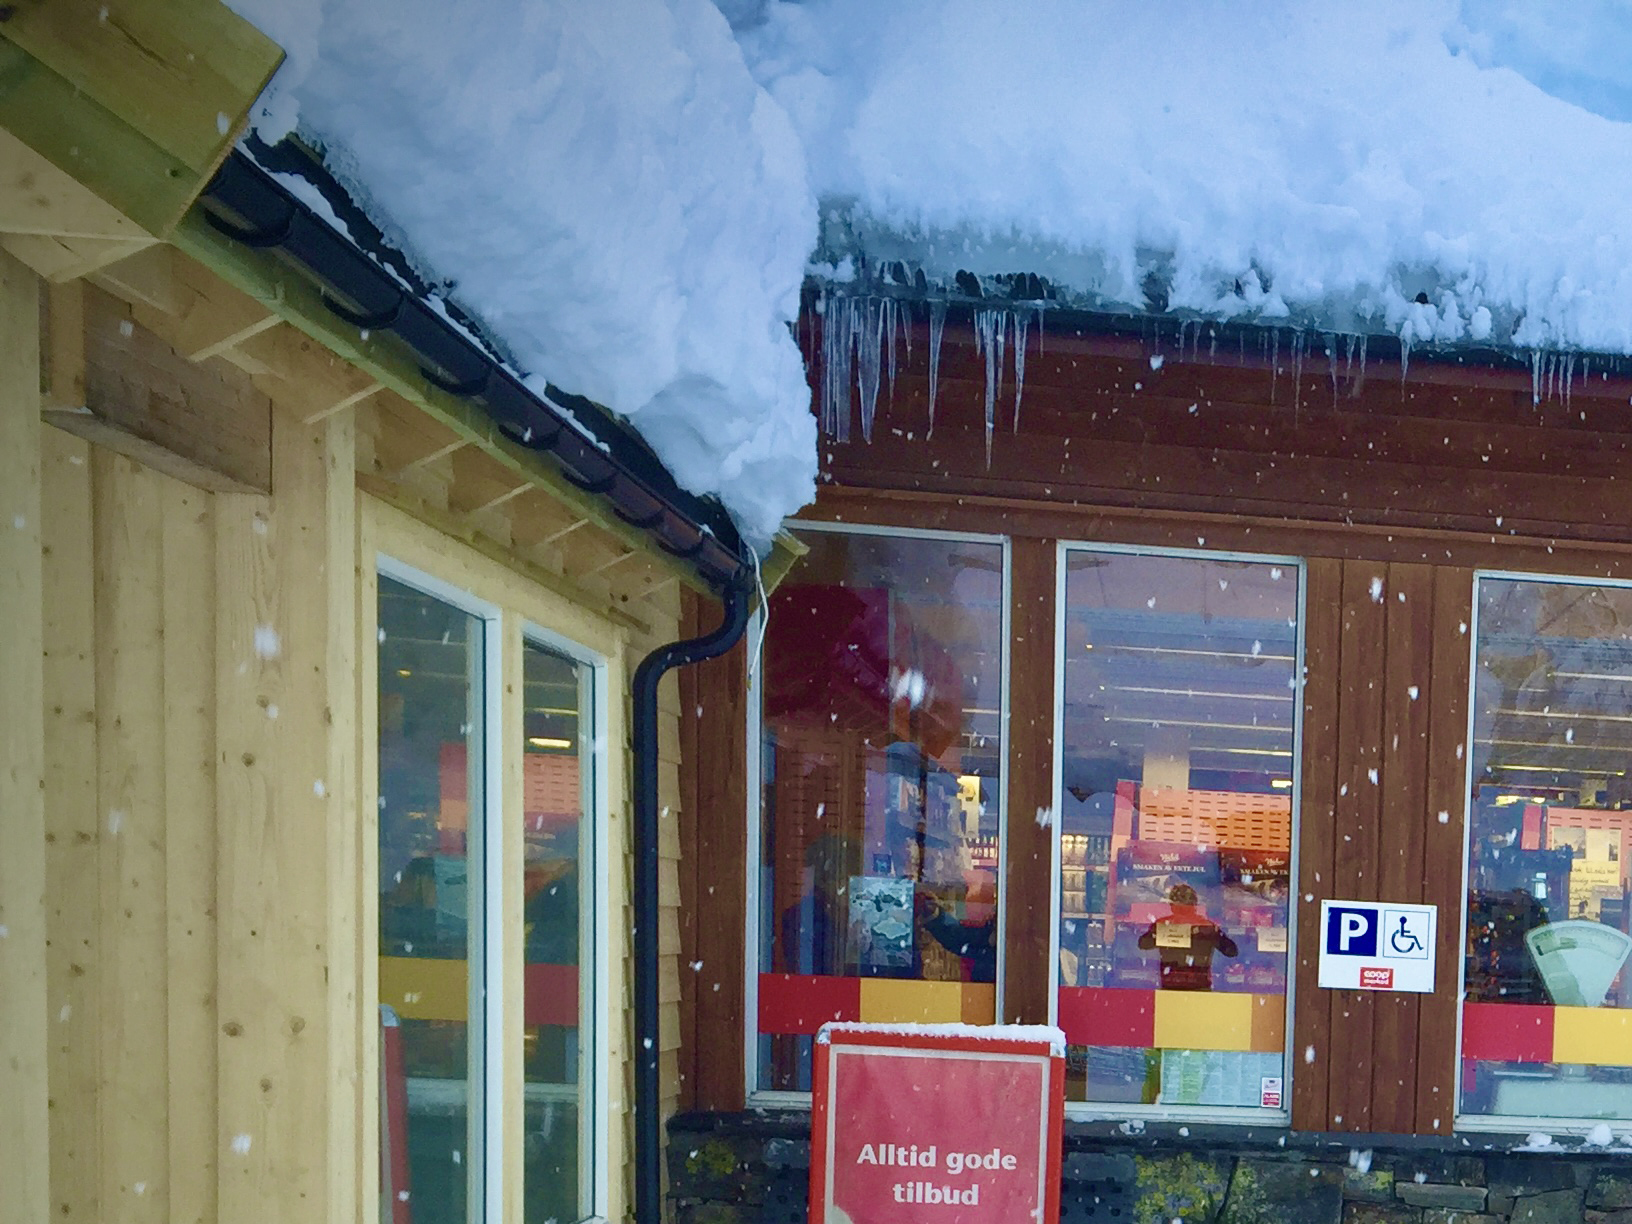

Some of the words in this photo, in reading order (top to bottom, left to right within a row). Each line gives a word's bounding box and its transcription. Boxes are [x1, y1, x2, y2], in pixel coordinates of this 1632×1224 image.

[1340, 912, 1369, 951] P
[856, 1143, 937, 1168] Alltid
[946, 1148, 1017, 1175] gode
[892, 1181, 979, 1206] tilbud
